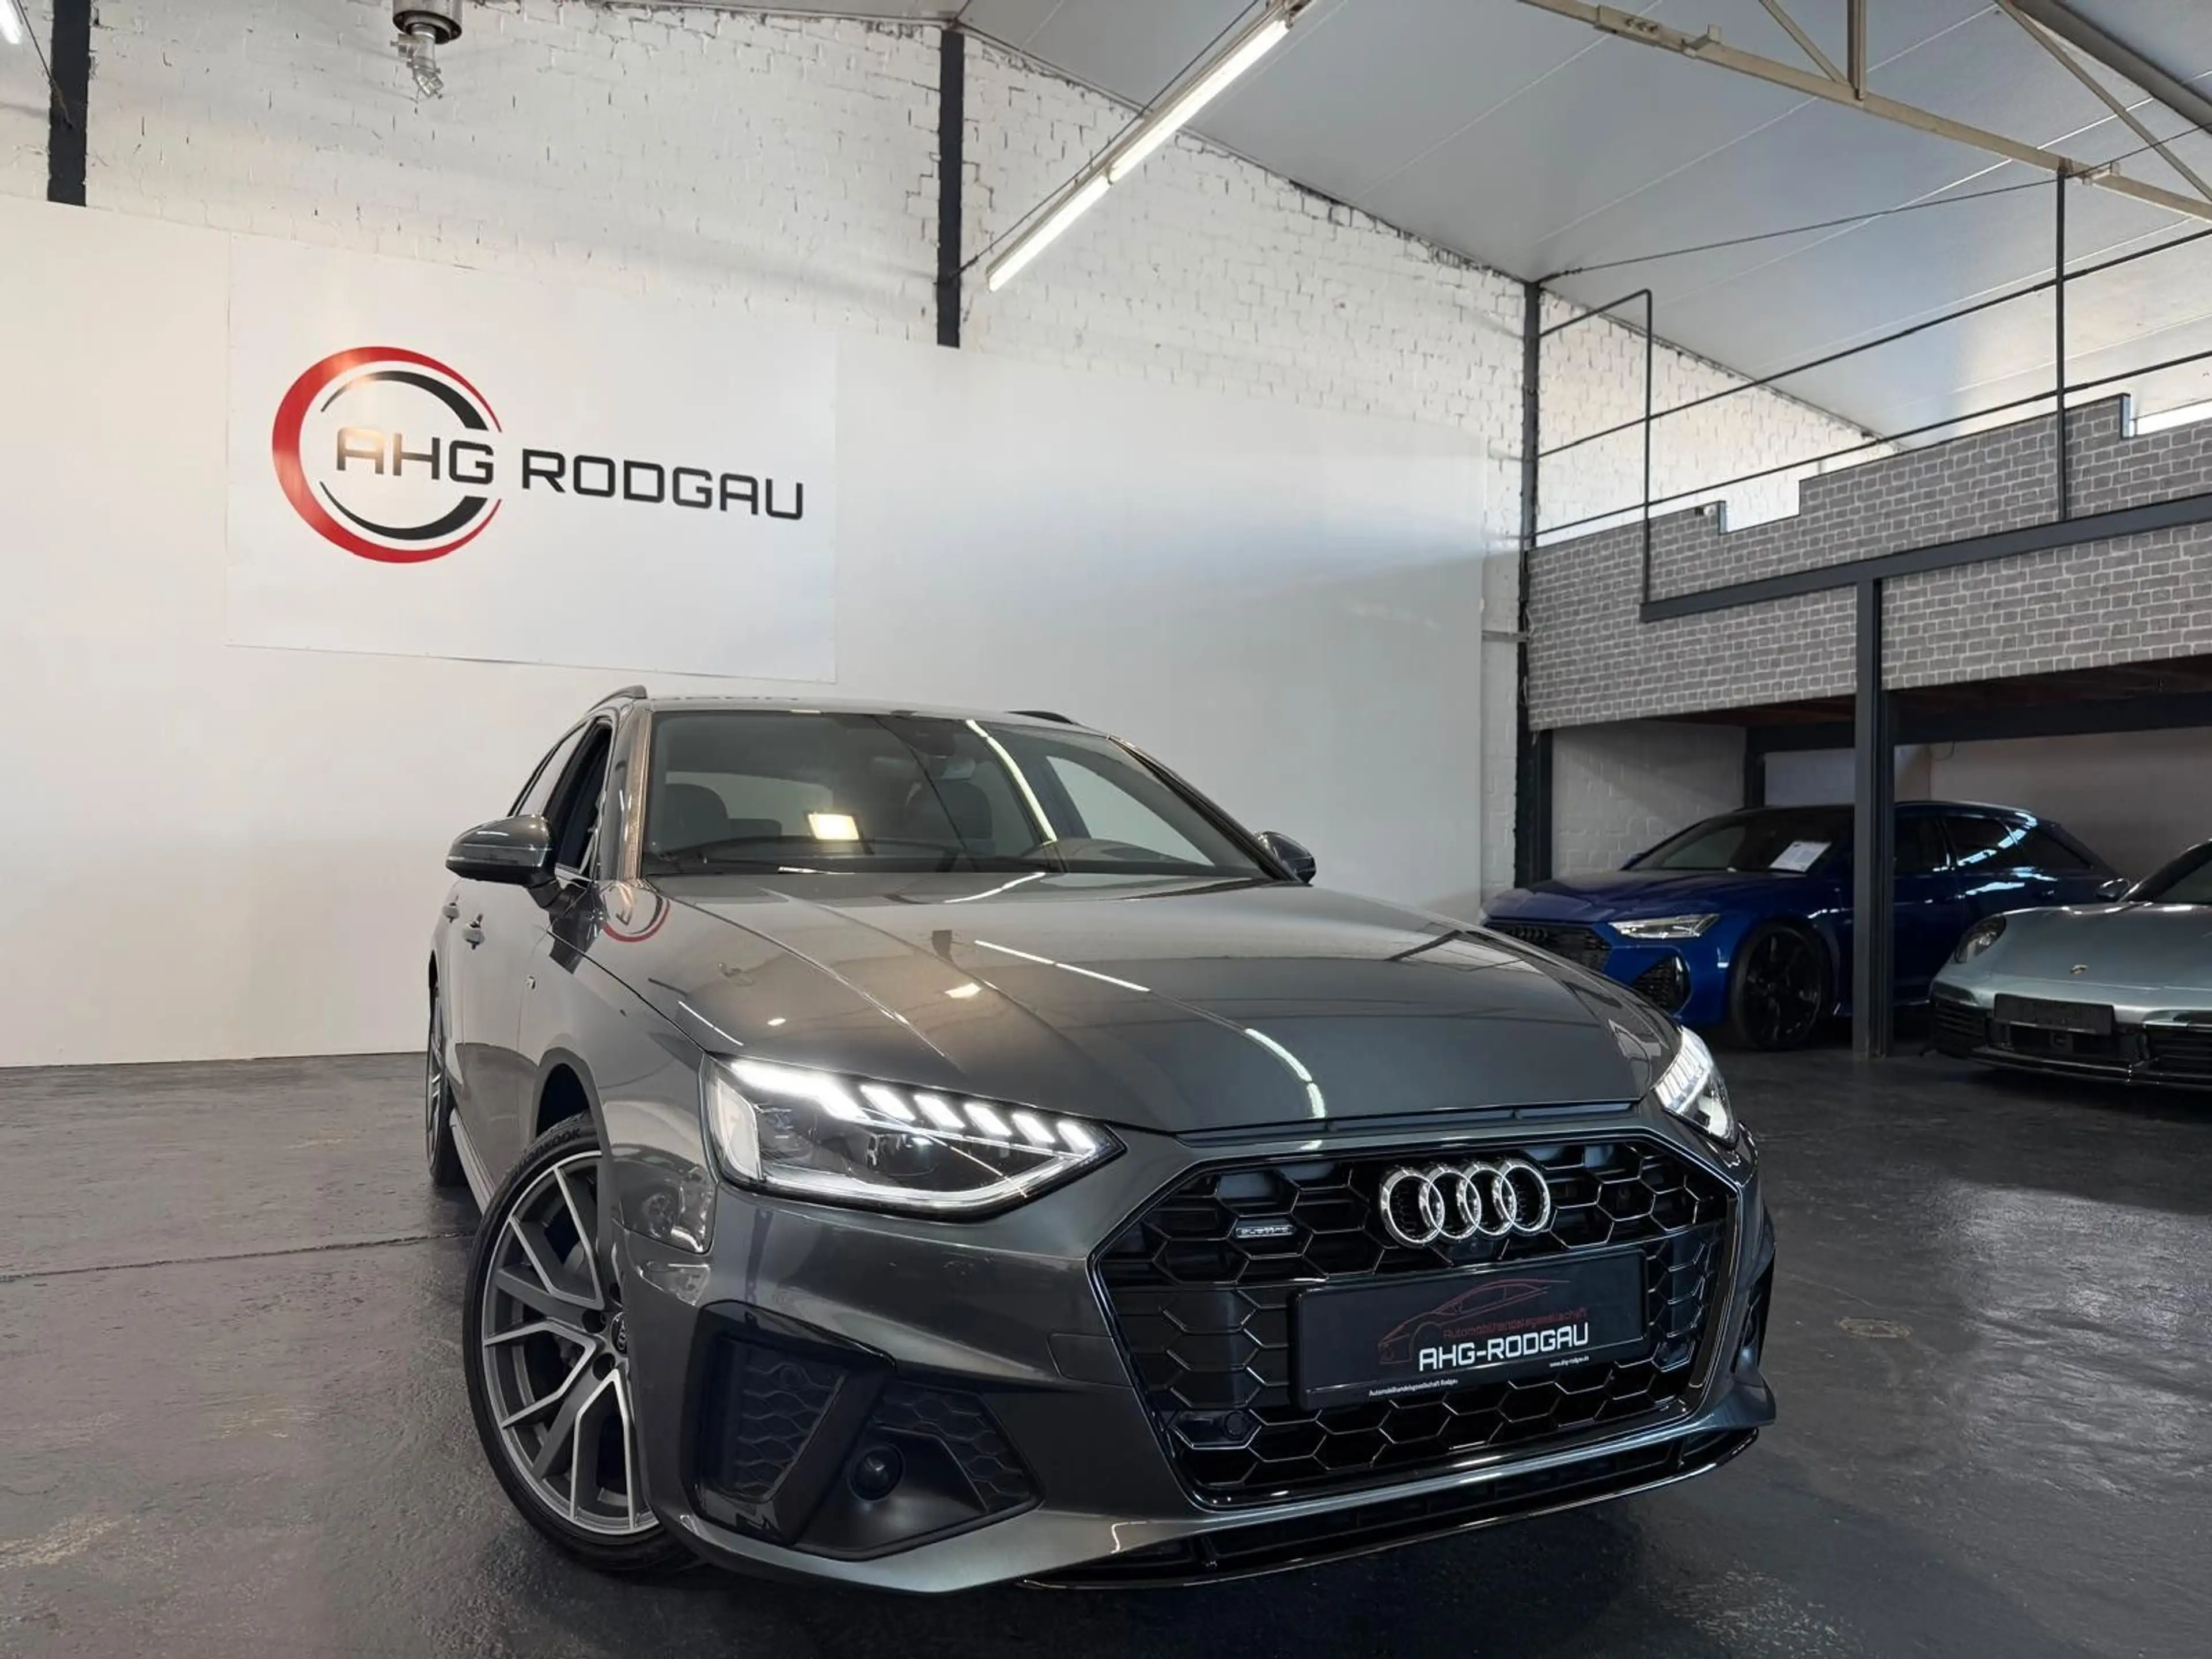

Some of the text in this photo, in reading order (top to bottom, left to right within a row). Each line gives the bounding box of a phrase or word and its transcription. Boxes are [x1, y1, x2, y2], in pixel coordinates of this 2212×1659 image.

[336, 426, 804, 521] AHG RODGAU
[1418, 1322, 1589, 1372] AHG-RODGAU
